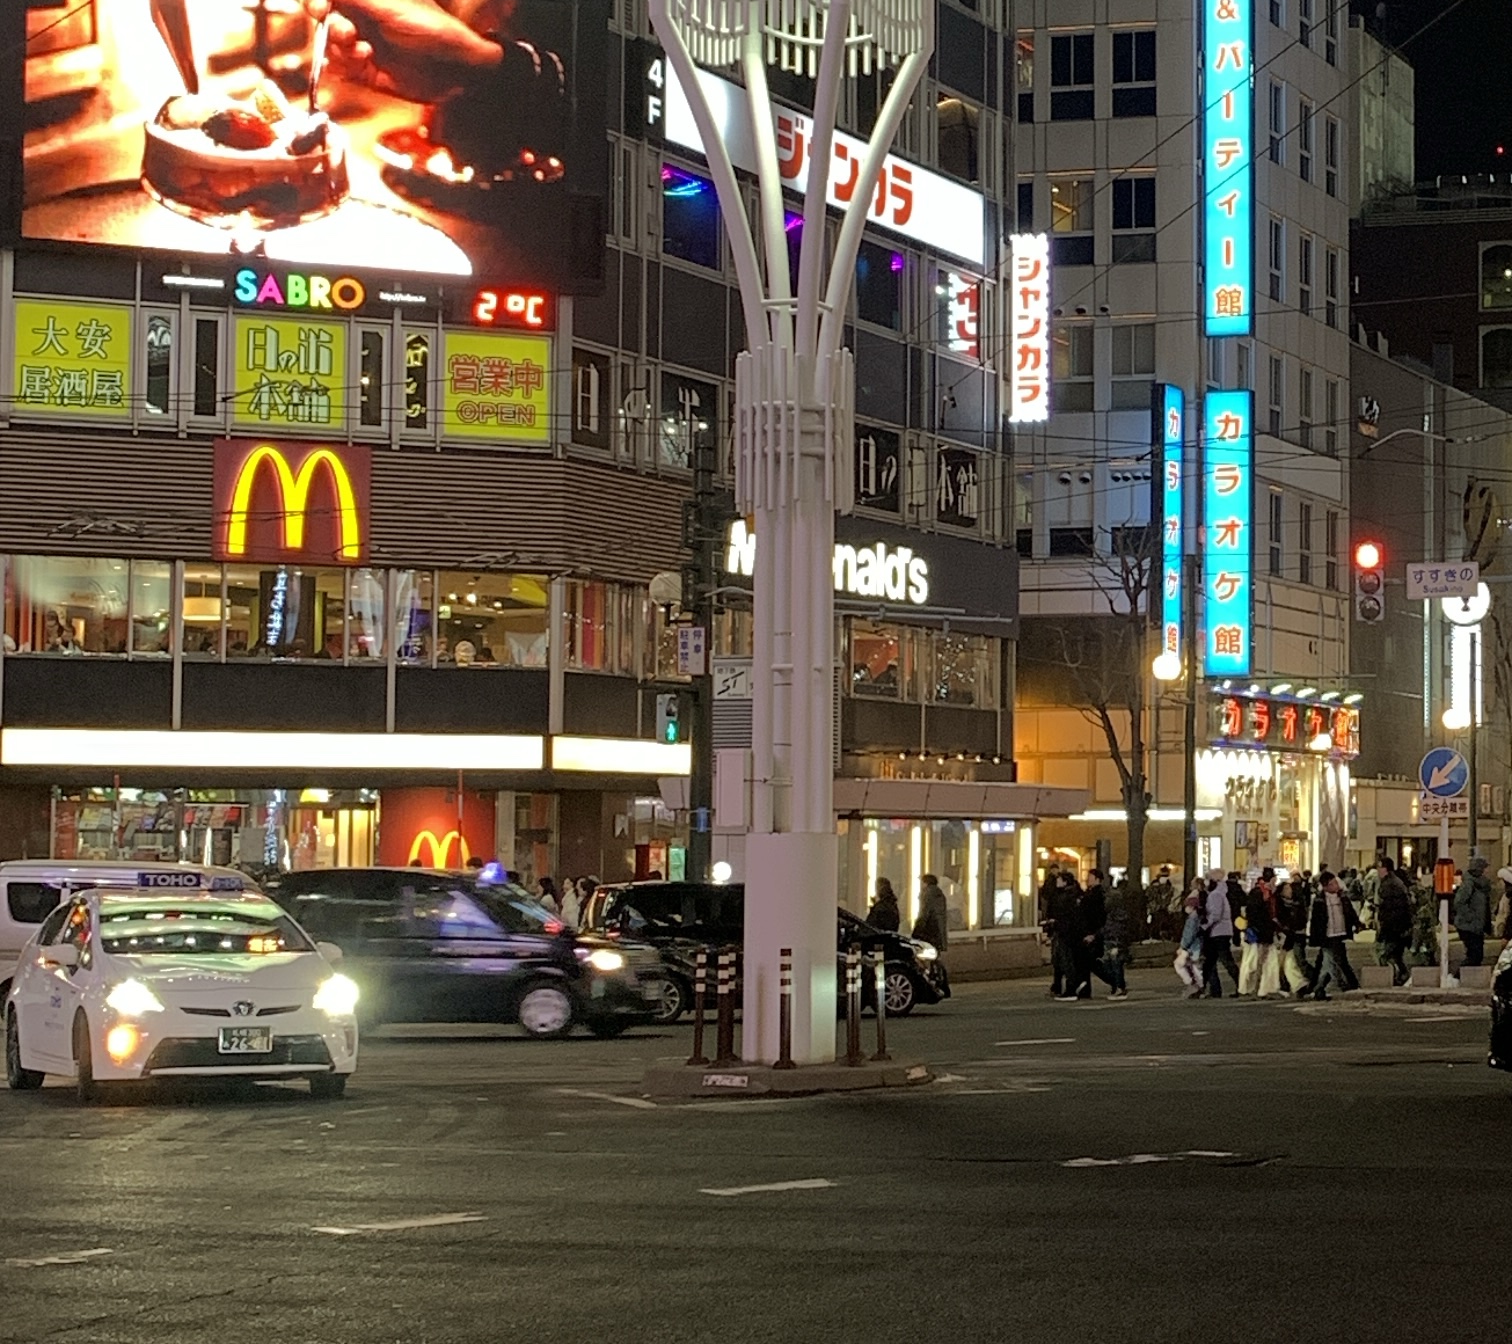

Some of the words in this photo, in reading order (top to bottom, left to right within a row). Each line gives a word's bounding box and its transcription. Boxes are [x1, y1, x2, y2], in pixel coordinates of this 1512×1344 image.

[777, 113, 913, 226] ジンラ
[235, 268, 366, 310] SABRO
[32, 316, 112, 359] 大安
[20, 365, 124, 408] 居酒屋
[450, 354, 544, 399] 営業中
[457, 402, 536, 426] OPEN
[1214, 411, 1242, 655] カラオケ館
[1412, 567, 1473, 585] すすきの
[1422, 803, 1467, 815] 中央分離帯
[145, 873, 197, 887] TOHO
